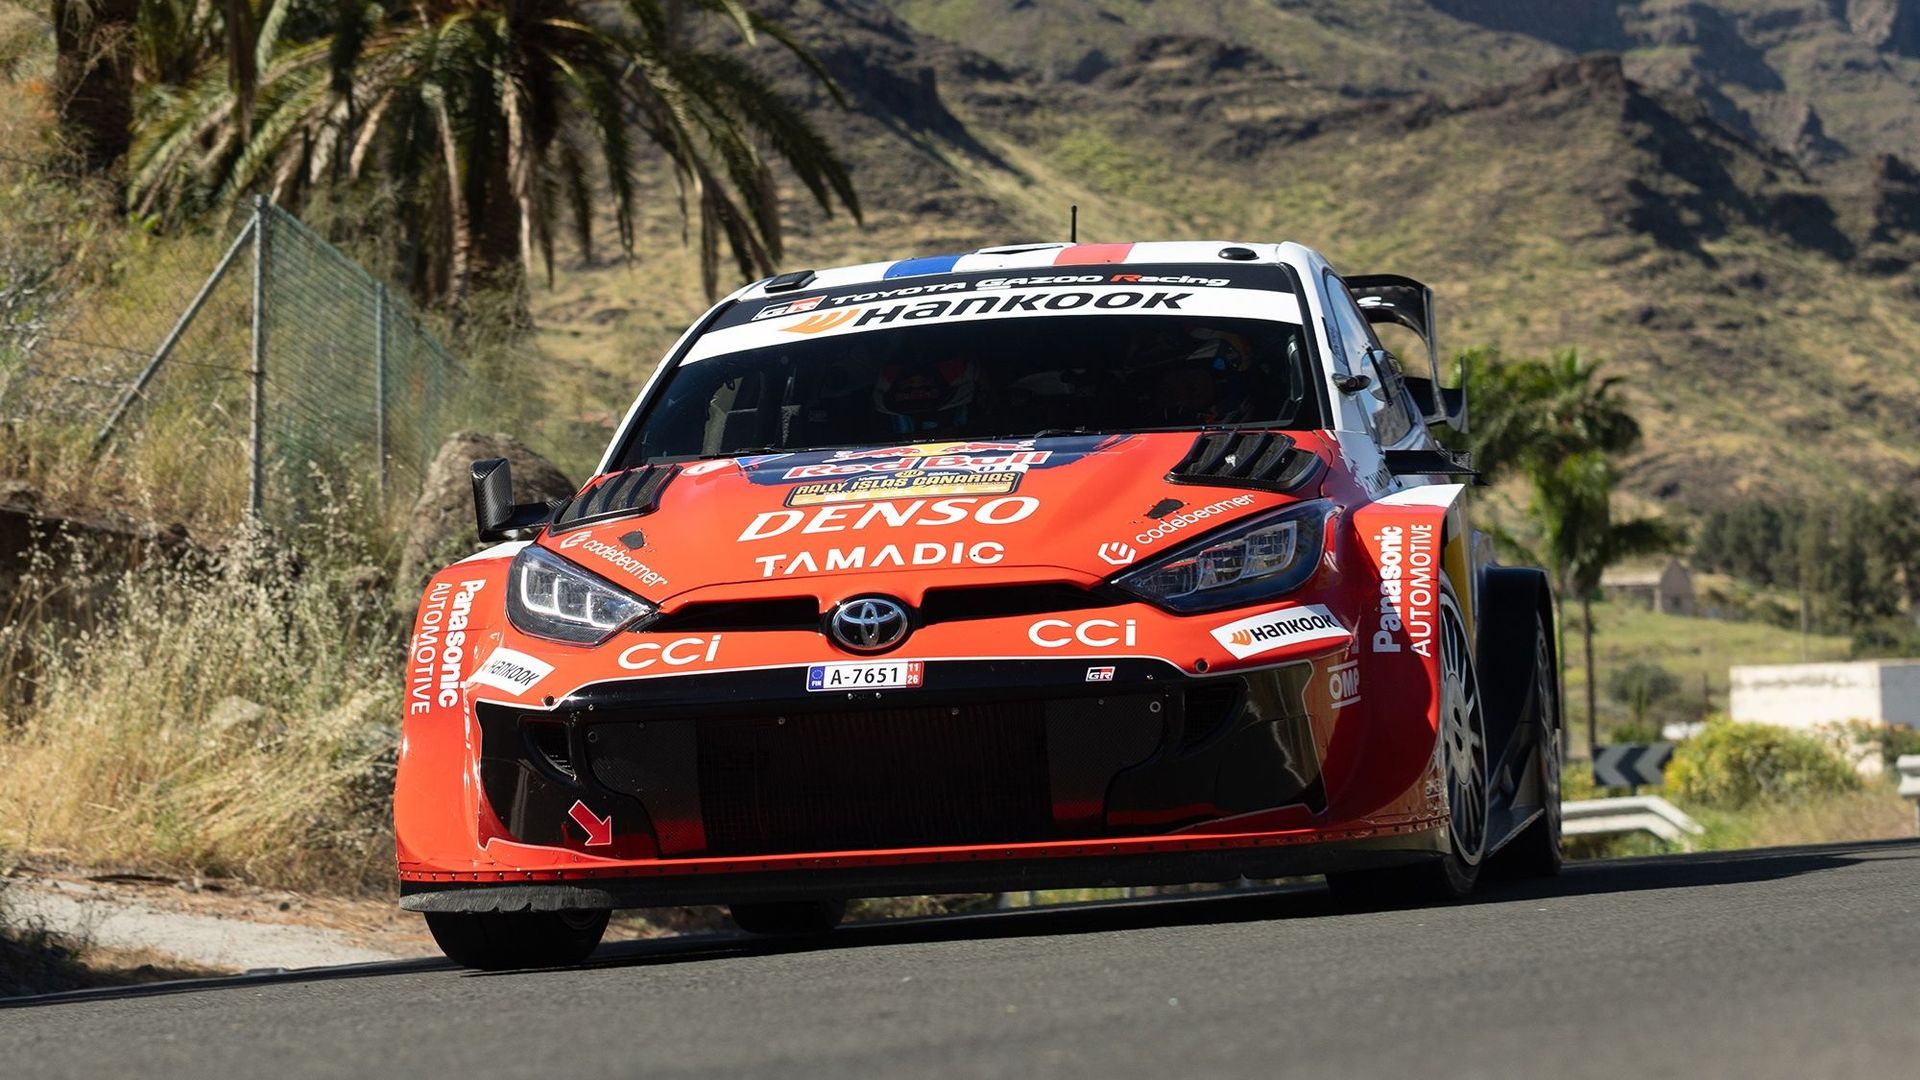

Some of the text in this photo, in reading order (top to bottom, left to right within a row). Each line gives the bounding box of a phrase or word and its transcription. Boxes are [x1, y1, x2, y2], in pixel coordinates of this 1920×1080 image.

[831, 281, 967, 305] TOYOTA
[975, 274, 1104, 291] GAZOO
[1109, 273, 1231, 287] Racing
[784, 457, 919, 478] Red
[923, 451, 1053, 468] Bull
[796, 482, 849, 496] RALLY
[851, 477, 908, 491] ISLAS
[912, 472, 1015, 486] CANARIAS
[737, 496, 1040, 542] DENSO
[1135, 493, 1255, 545] codebeamer
[583, 539, 667, 587] codebeamer
[755, 541, 1005, 578] TAMADIC
[1373, 525, 1403, 653] Panasonic
[1409, 524, 1432, 658] AUTOMOTIVE
[410, 582, 452, 715] AUTOMOTIVE
[438, 579, 487, 708] Panasonic
[830, 667, 899, 685] A-7651
[907, 674, 919, 685] 26
[908, 662, 919, 672] 11
[1087, 669, 1114, 681] GR
[1328, 667, 1360, 700] OMP
